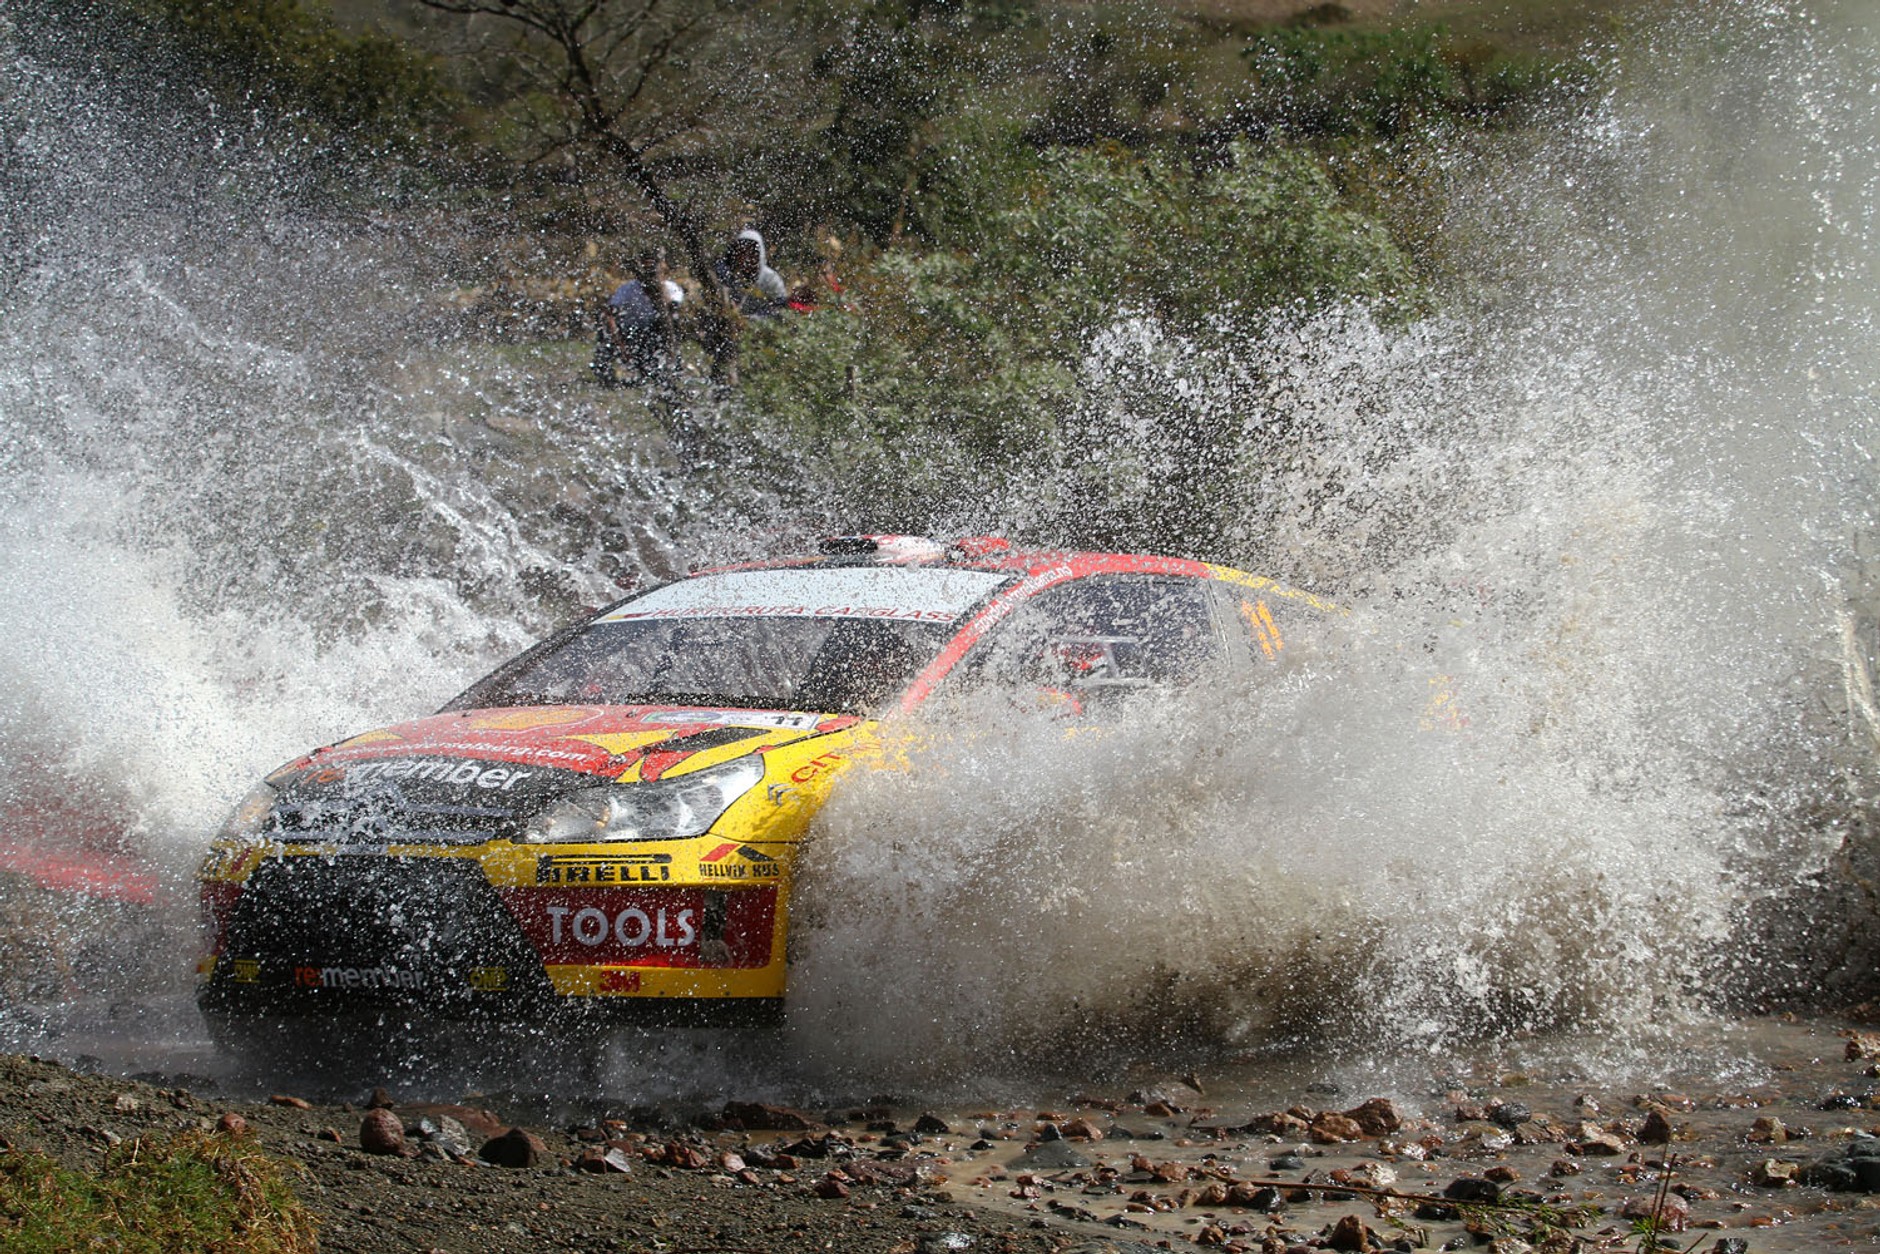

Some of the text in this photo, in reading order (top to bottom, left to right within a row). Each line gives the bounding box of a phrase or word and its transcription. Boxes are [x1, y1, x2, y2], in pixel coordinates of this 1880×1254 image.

[814, 605, 957, 622] CARGLASS
[771, 715, 803, 726] 11
[536, 853, 672, 882] PIRELLI
[546, 906, 696, 948] TOOLS
[600, 970, 640, 992] 3M
